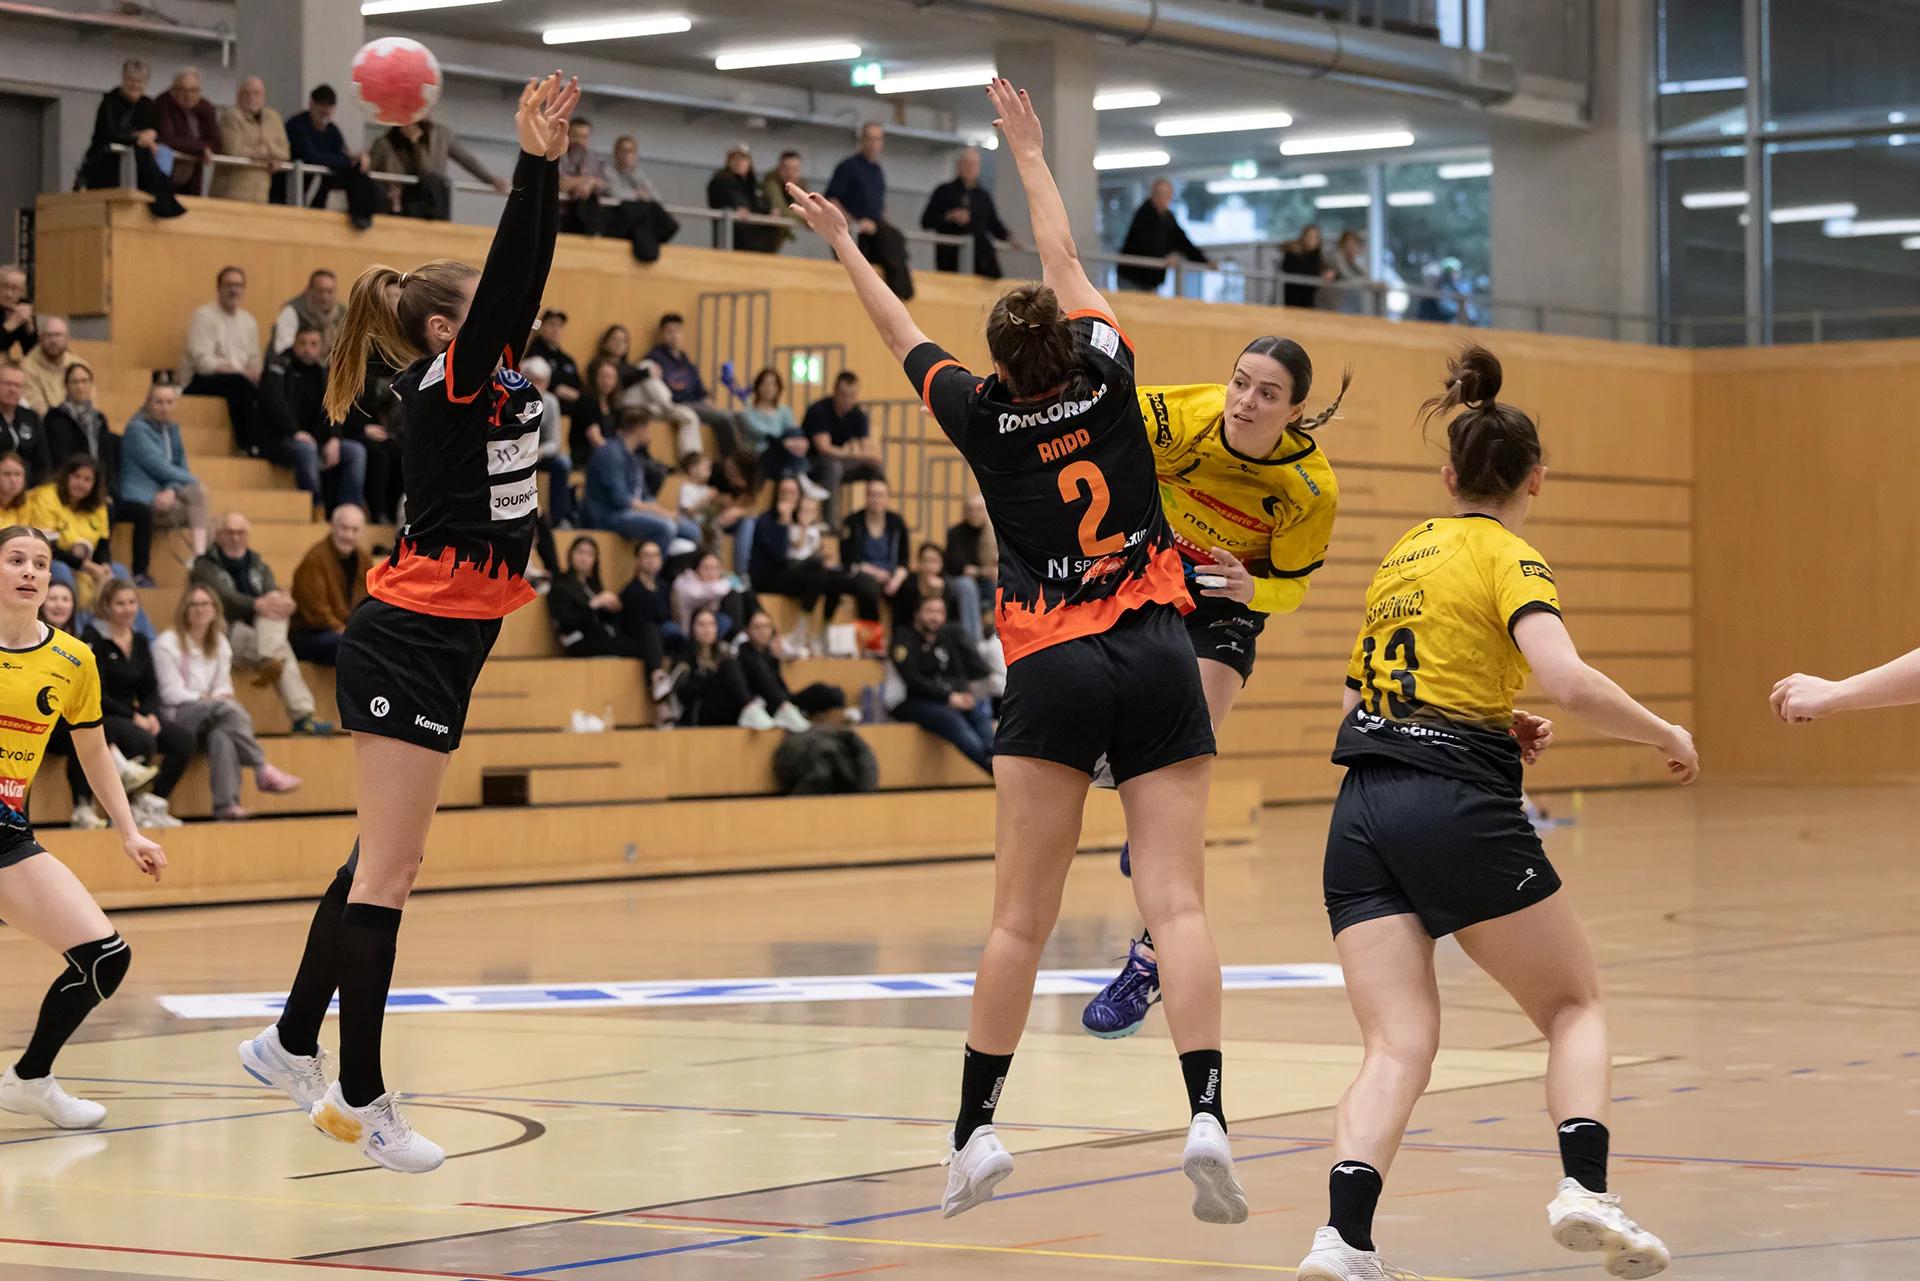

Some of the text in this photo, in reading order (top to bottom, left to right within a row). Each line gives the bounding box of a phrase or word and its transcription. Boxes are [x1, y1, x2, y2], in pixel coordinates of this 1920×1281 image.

[1057, 460, 1127, 557] 2
[1362, 627, 1420, 719] 13
[414, 714, 449, 735] Kempa
[1198, 1068, 1220, 1104] Kempa
